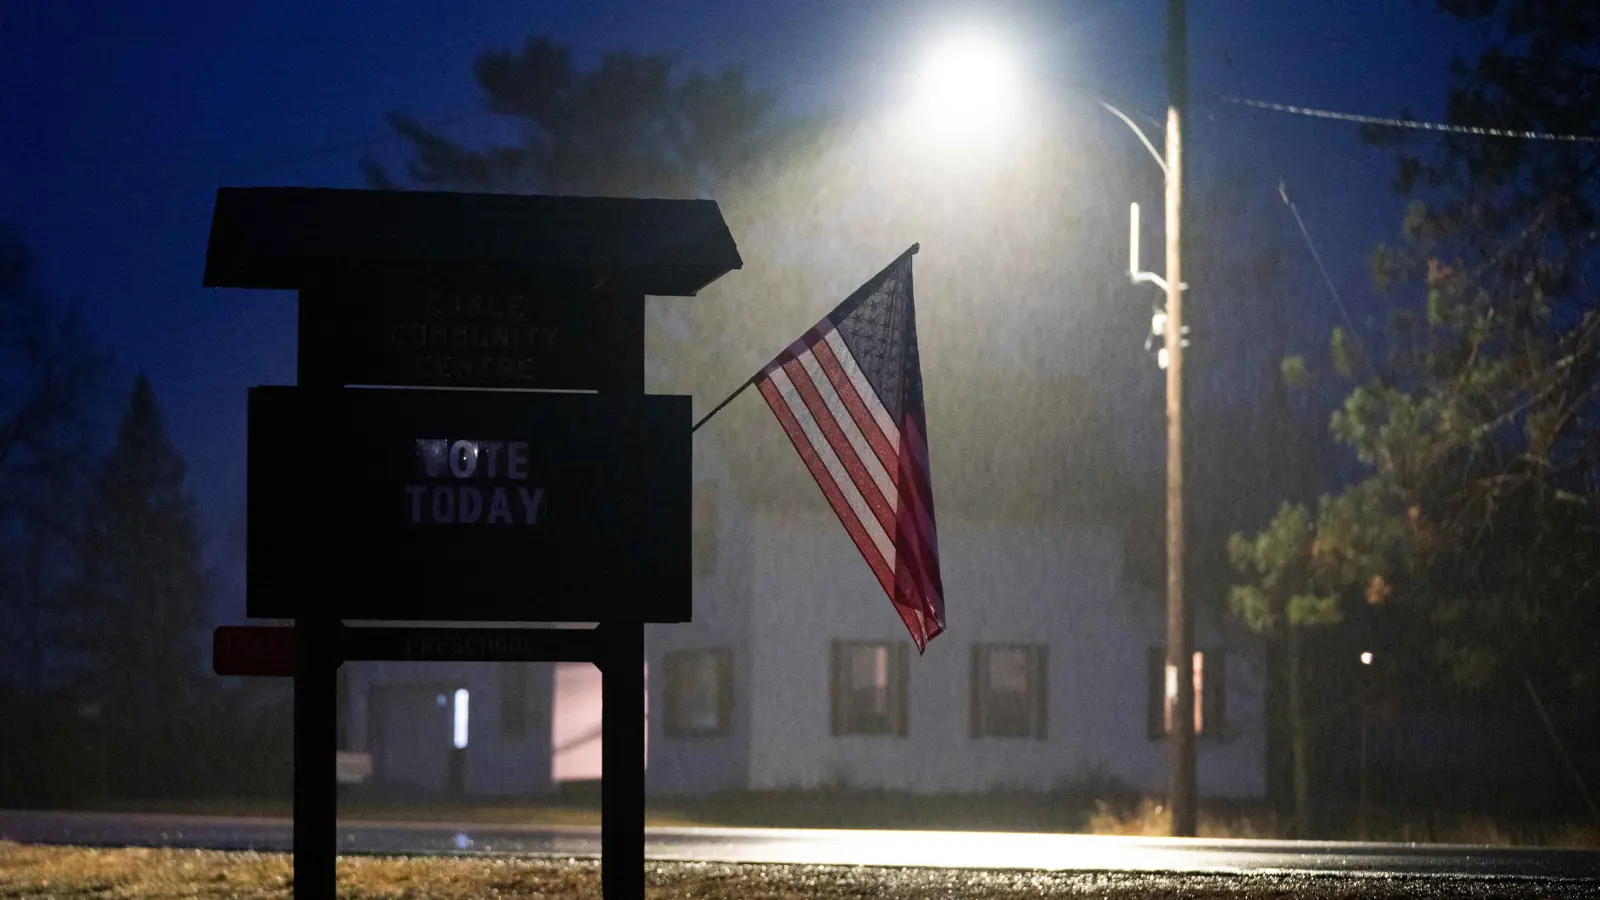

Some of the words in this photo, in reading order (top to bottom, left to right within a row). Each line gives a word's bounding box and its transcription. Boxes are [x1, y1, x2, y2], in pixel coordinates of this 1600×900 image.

[391, 323, 560, 349] COMMUNITY
[414, 354, 536, 380] CENTRE
[415, 438, 530, 480] VOTE
[404, 484, 545, 525] TODAY
